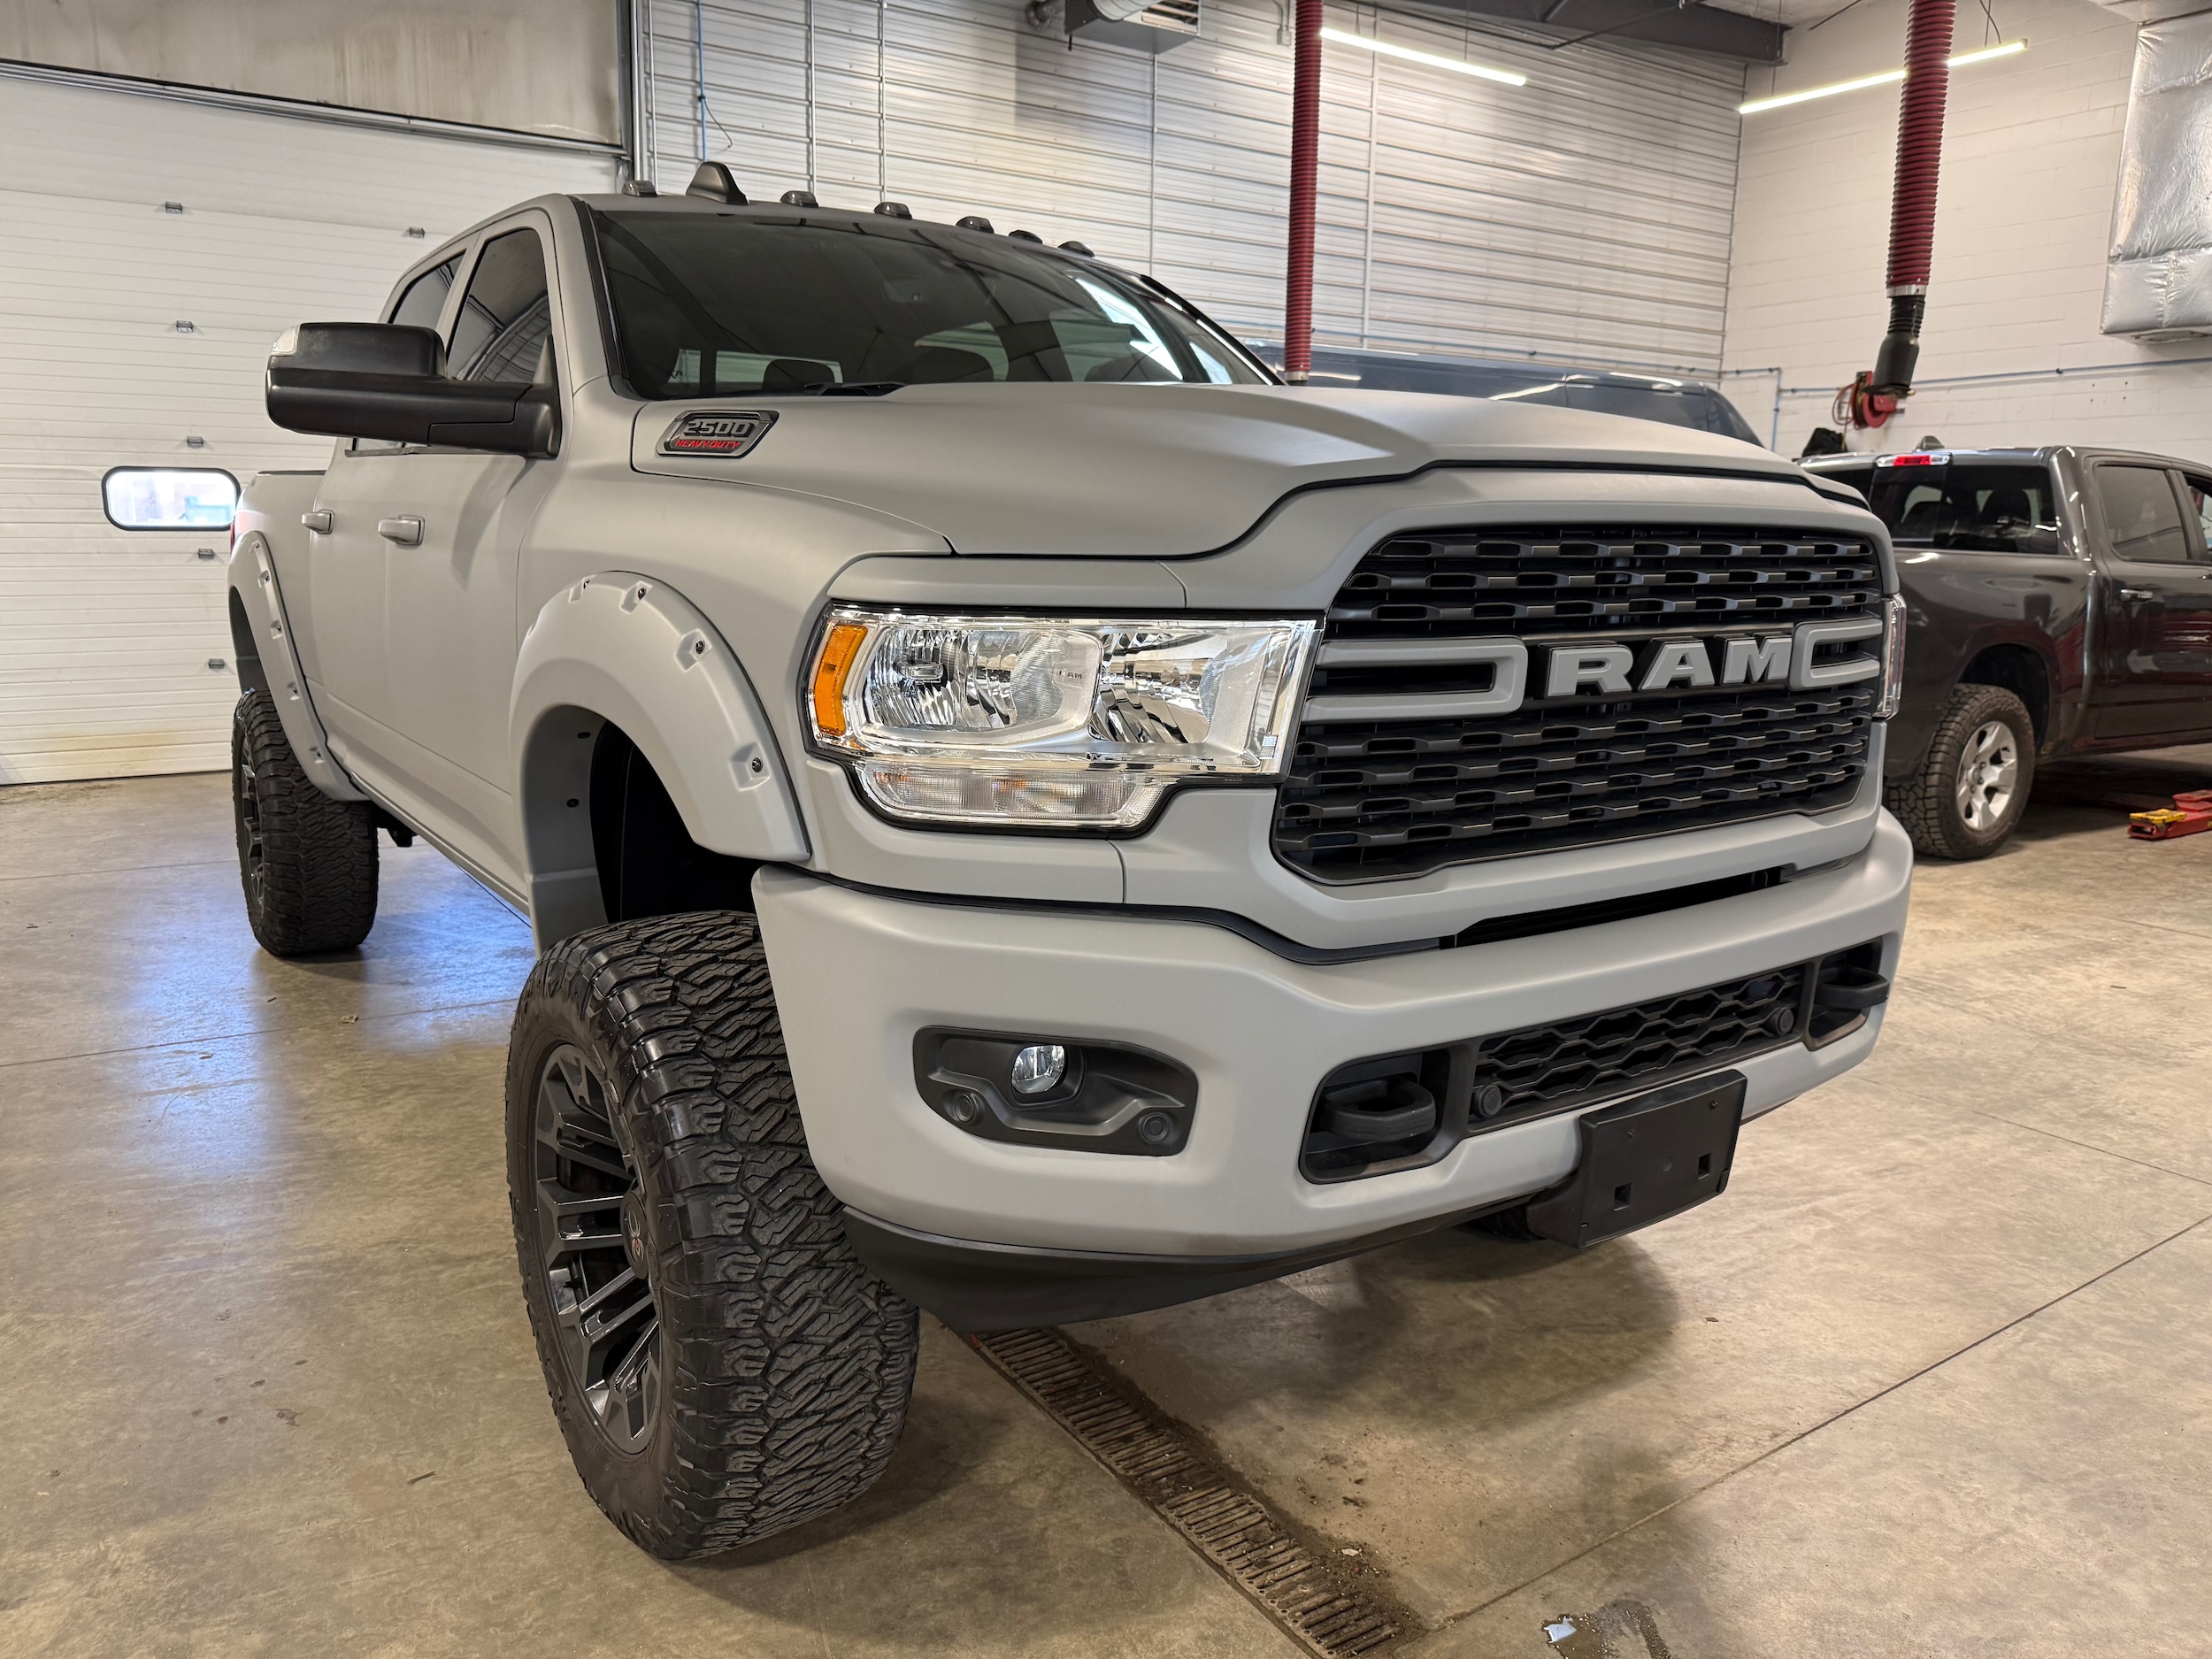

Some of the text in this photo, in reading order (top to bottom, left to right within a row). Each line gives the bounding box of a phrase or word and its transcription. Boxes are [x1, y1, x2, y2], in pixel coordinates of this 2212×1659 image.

[684, 421, 751, 437] 2500
[675, 440, 741, 449] HEAVY DUTY
[1545, 634, 1793, 697] RAM
